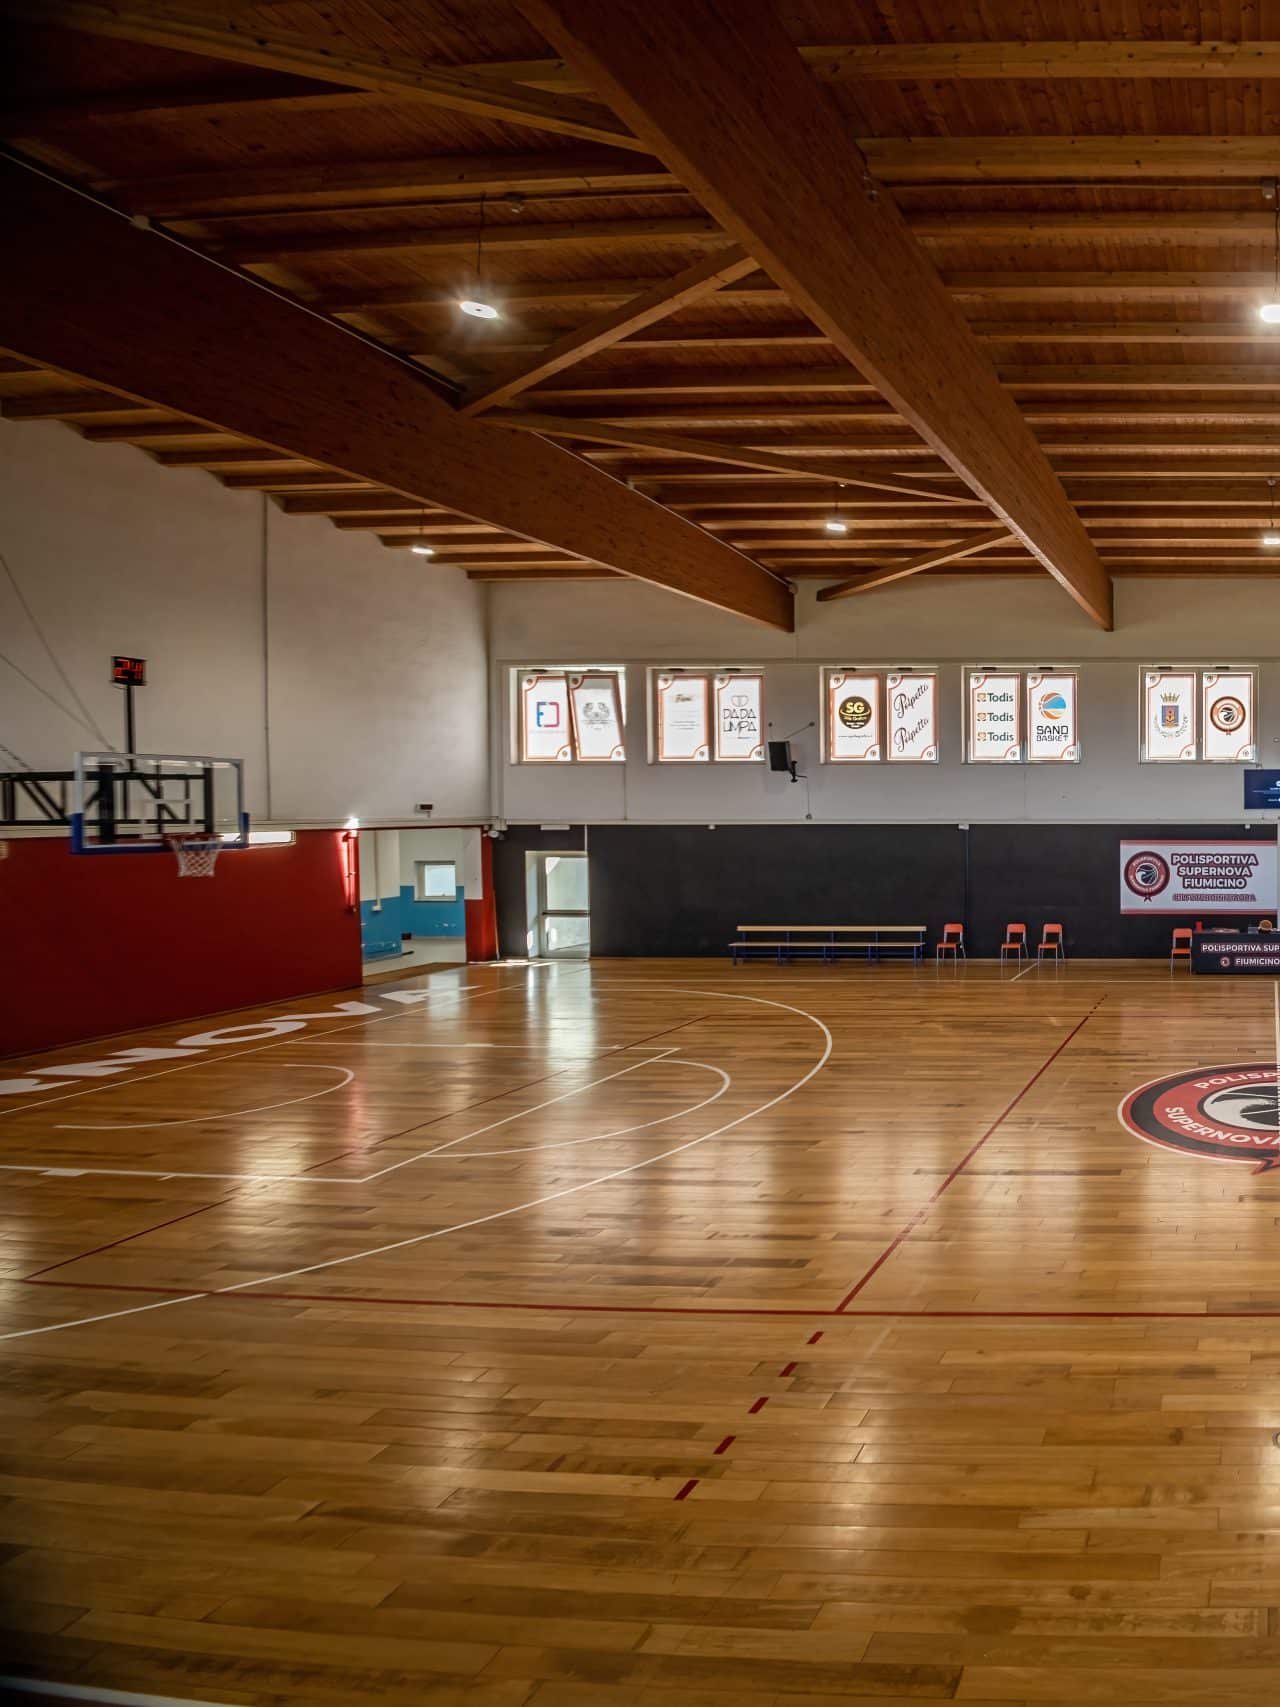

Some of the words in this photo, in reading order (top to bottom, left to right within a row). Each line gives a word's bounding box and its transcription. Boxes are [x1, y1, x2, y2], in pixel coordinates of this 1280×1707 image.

[113, 659, 144, 679] 24
[987, 692, 1014, 702] Todis
[845, 702, 865, 713] SG
[987, 712, 1014, 722] Todis
[1036, 725, 1068, 735] SAND
[987, 732, 1014, 742] Todis
[1172, 855, 1257, 864] POLISPORTIVA
[1178, 866, 1251, 876] SUPERNOVA
[1184, 878, 1245, 888] FIUMICINO
[1202, 944, 1261, 952] POLISPORTIVA
[1235, 958, 1280, 966] FIUMICINO
